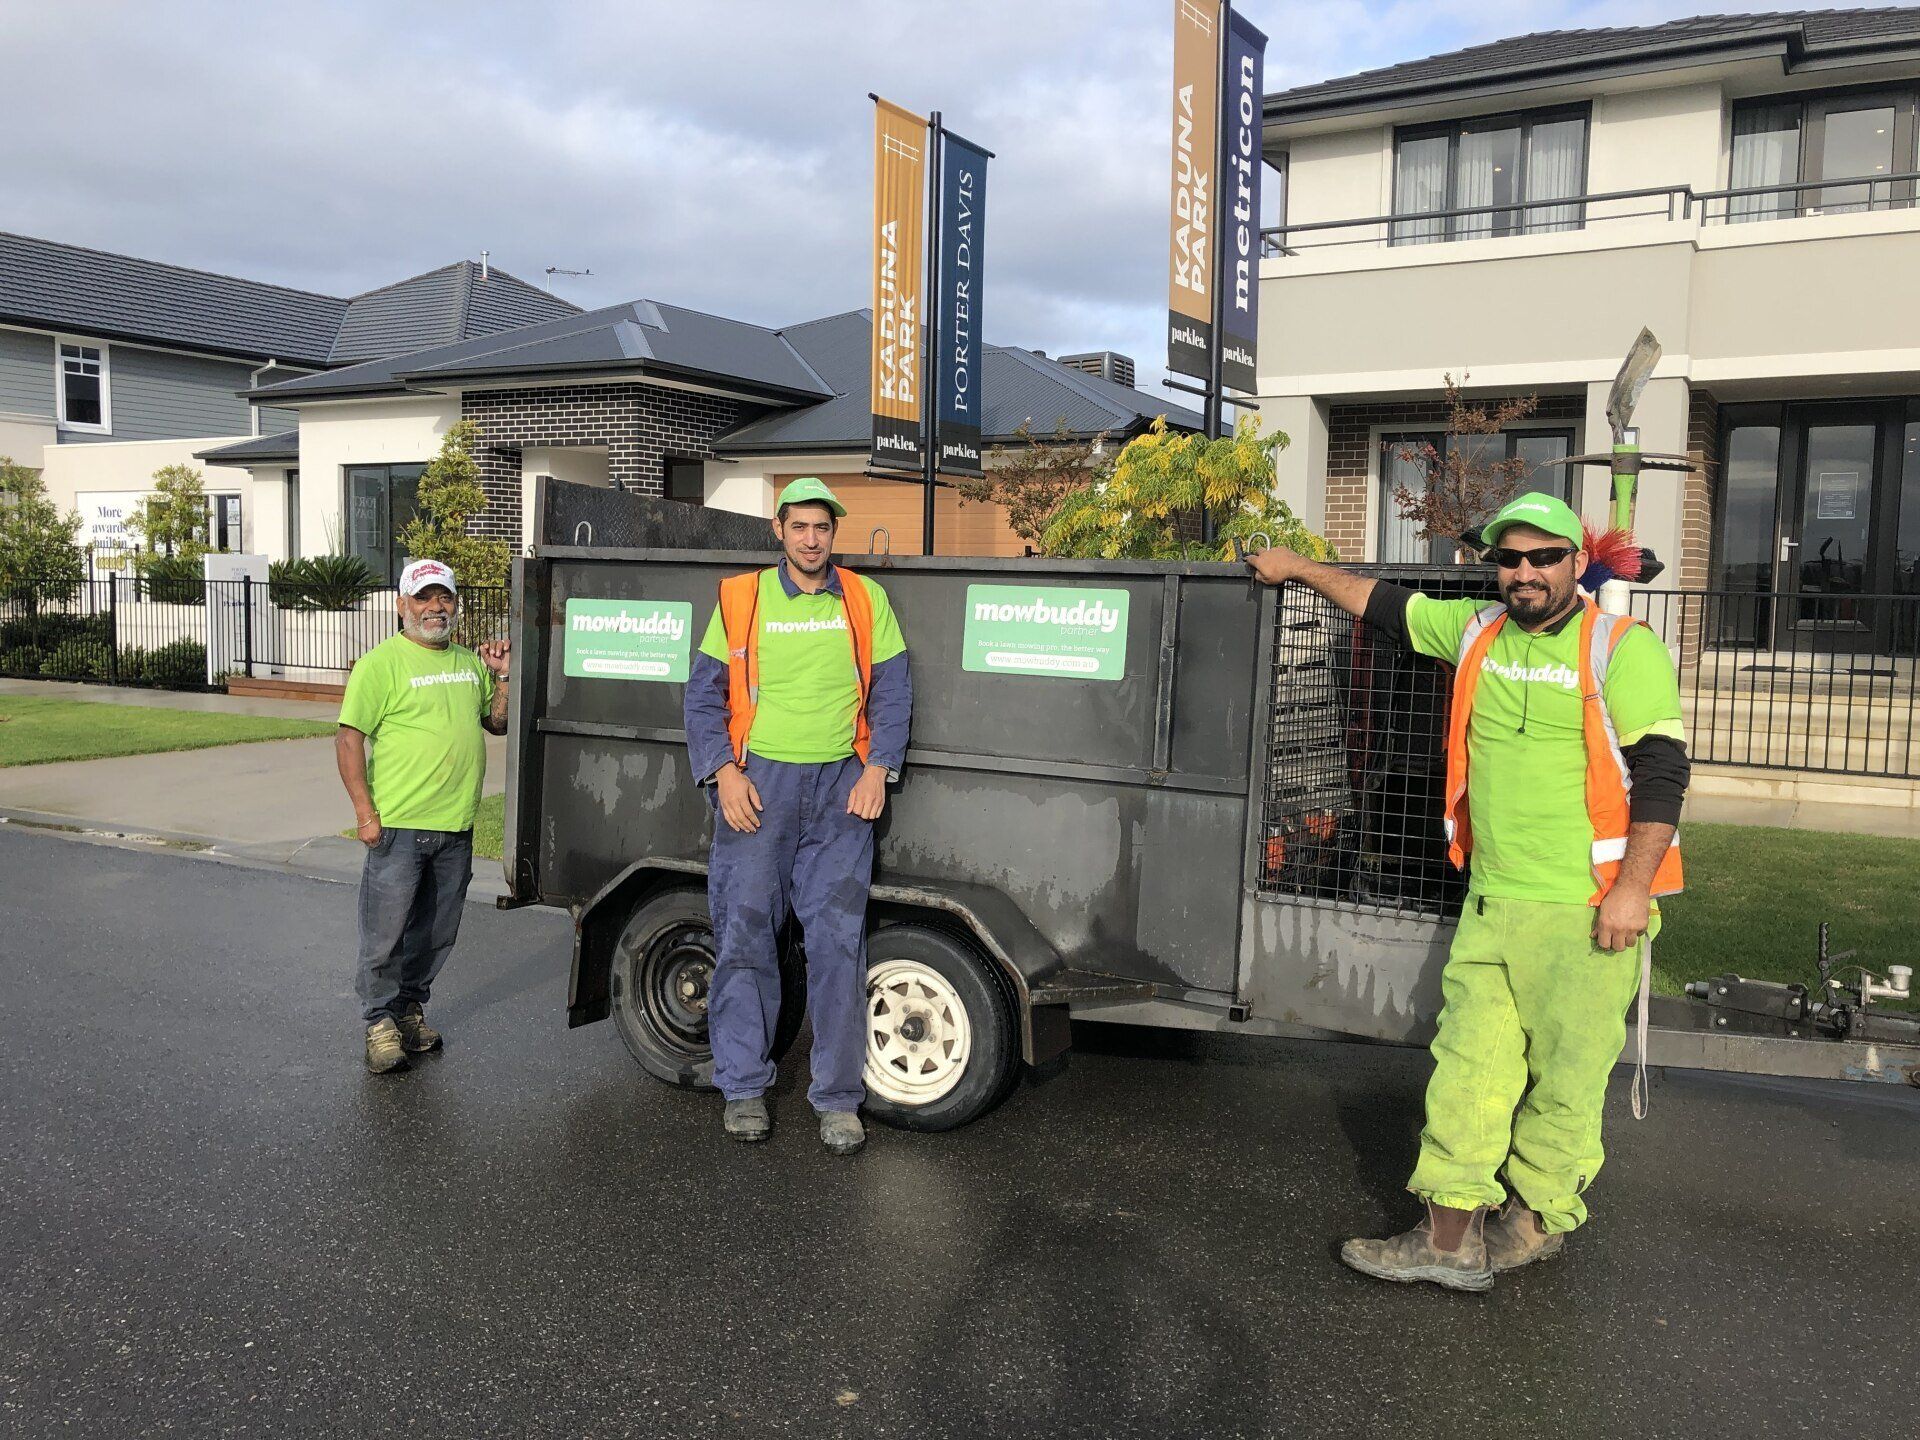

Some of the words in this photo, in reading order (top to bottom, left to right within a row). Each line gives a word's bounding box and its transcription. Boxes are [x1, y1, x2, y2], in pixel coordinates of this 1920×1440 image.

[1175, 84, 1193, 288] KADUNA
[1232, 55, 1254, 312] metricon
[957, 169, 973, 271] DAVIS
[1191, 166, 1208, 294] PARK
[880, 220, 898, 400] KADUNA
[898, 293, 915, 403] PARK
[955, 279, 970, 413] PORTER
[1171, 326, 1207, 350] parklea.
[1223, 346, 1255, 368] parklea.
[876, 434, 917, 452] parklea.
[943, 443, 979, 460] parklea.
[97, 506, 122, 518] More
[92, 521, 129, 534] awards
[572, 610, 685, 641] mowbuddy
[765, 614, 848, 634] mowbud
[974, 597, 1119, 633] mowbuddy
[1060, 626, 1099, 636] partner
[977, 640, 993, 648] Book
[1000, 641, 1015, 649] lawn
[1018, 643, 1044, 652] mowing
[1074, 645, 1094, 653] better
[1095, 647, 1110, 655] way
